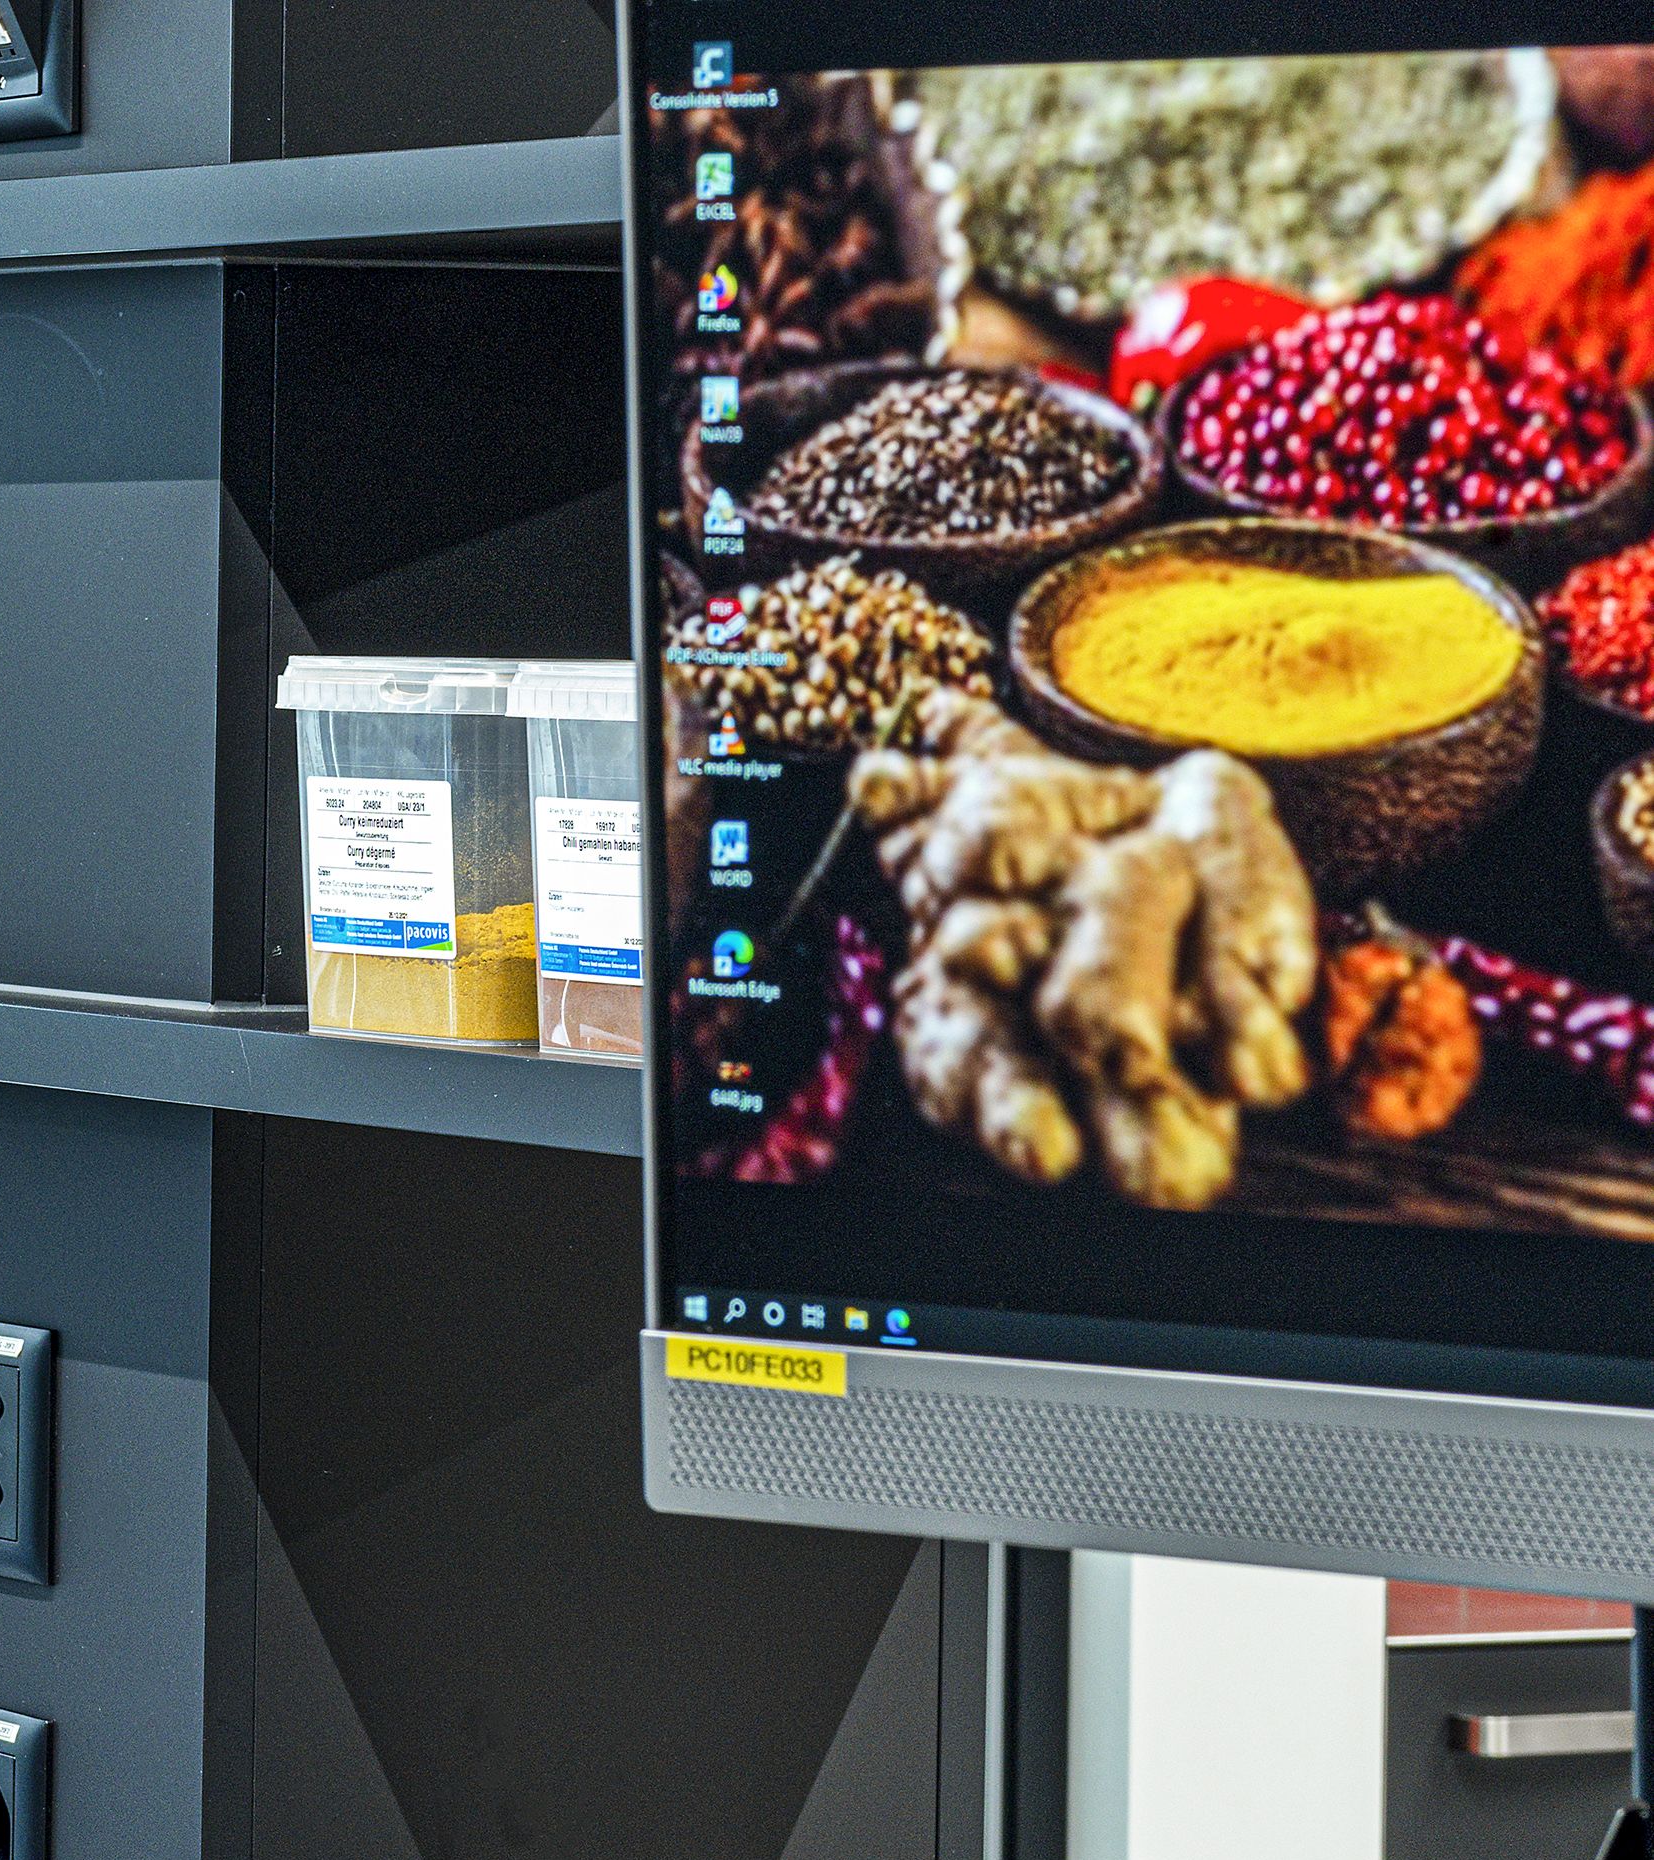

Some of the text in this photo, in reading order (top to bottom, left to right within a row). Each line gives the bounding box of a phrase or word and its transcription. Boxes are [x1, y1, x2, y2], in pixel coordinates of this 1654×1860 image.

[696, 202, 736, 220] EXCEL
[697, 314, 741, 332] Firefox
[677, 757, 783, 781] VLC media player
[338, 814, 404, 829] Curry keimreduziert
[347, 844, 396, 861] Curry dégermé
[578, 838, 612, 852] gemahlen
[710, 869, 753, 887] WORD
[406, 923, 448, 942] pacovis
[688, 977, 781, 1003] Microsoft Edge
[687, 1346, 823, 1384] PC10FE033
